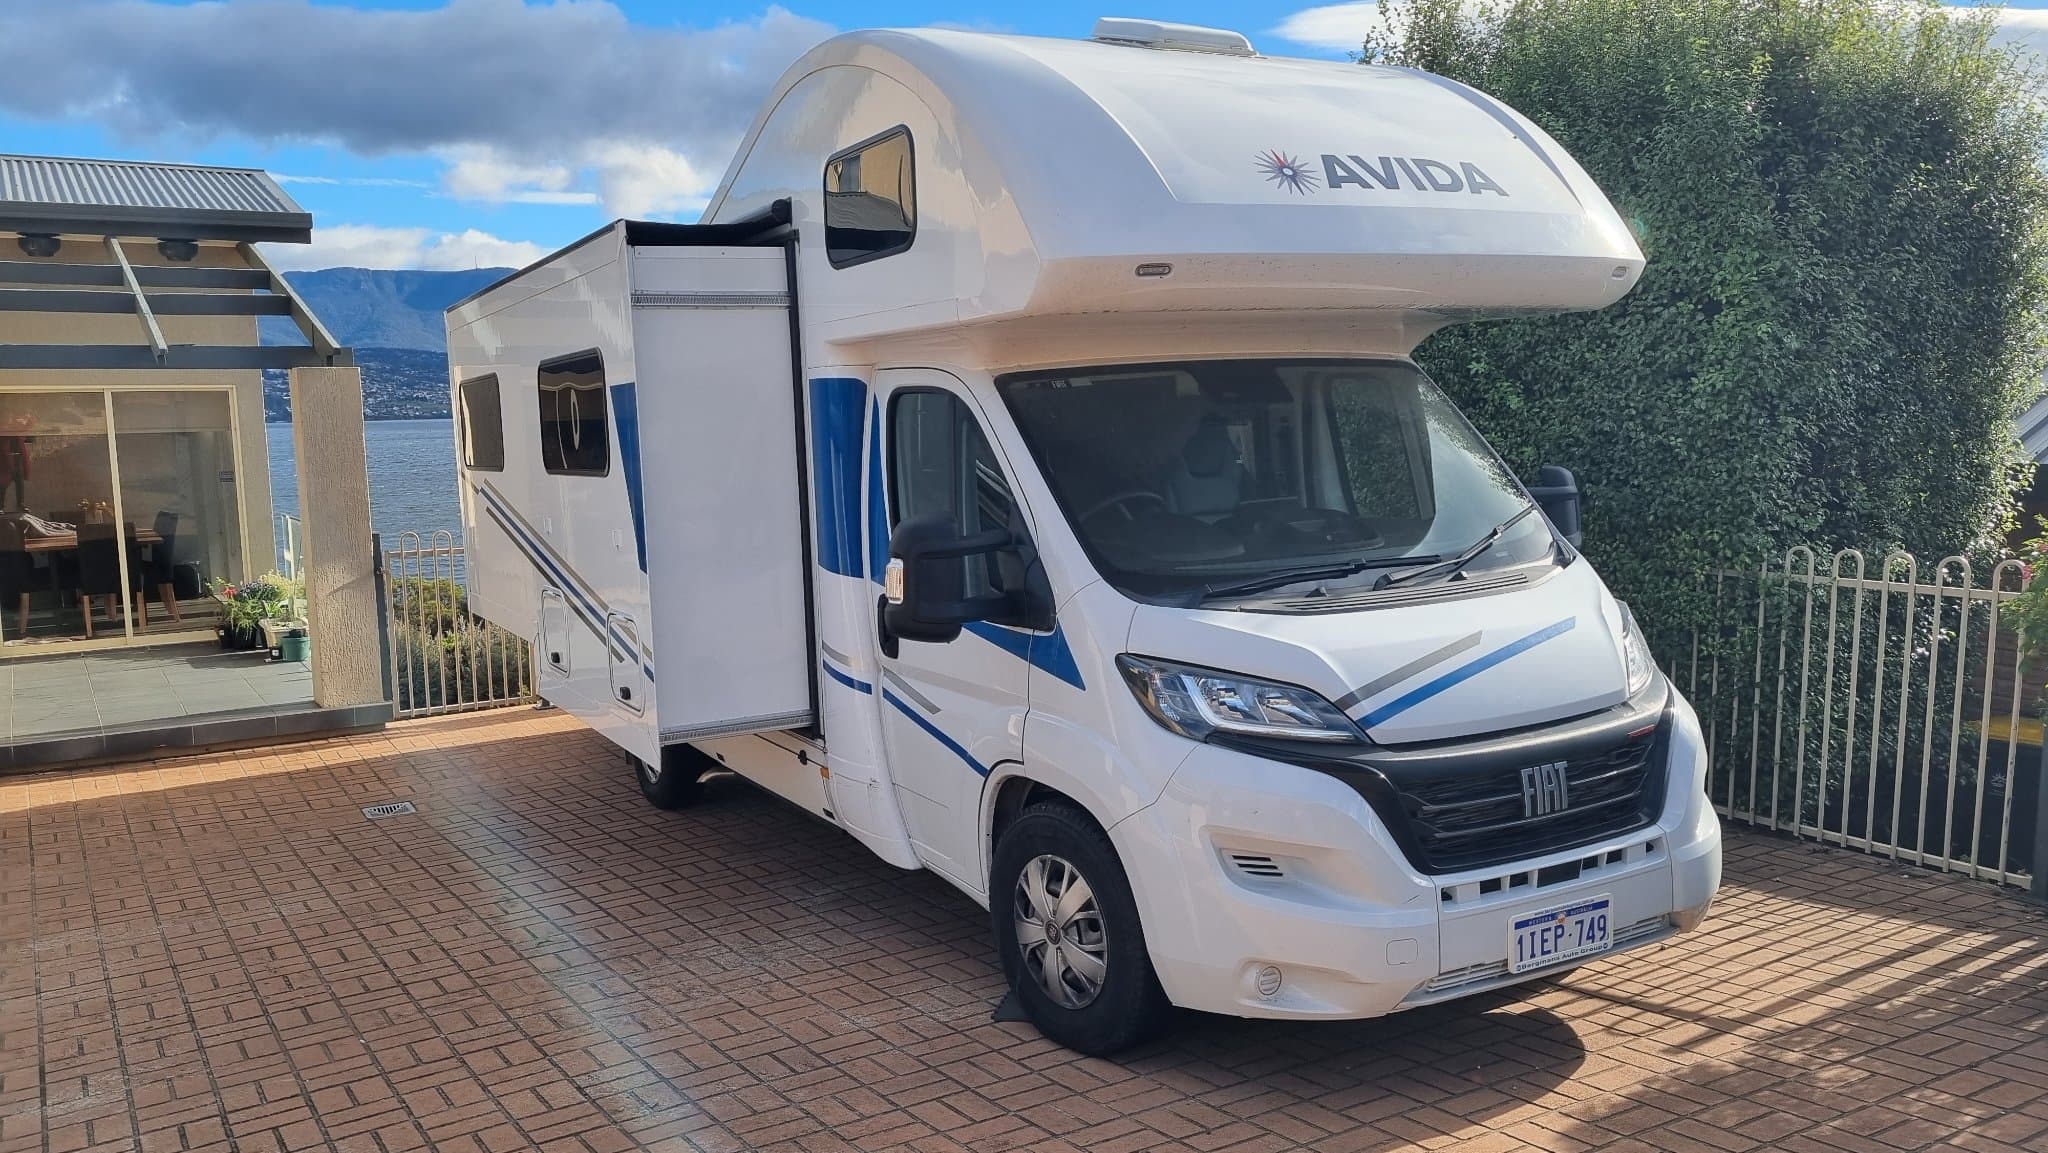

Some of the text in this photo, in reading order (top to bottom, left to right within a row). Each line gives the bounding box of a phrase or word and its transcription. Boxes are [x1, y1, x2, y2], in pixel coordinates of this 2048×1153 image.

[1320, 154, 1510, 197] AVIDA
[1520, 760, 1569, 817] FIAT
[1562, 951, 1580, 960] Auto
[1580, 945, 1603, 954] Group
